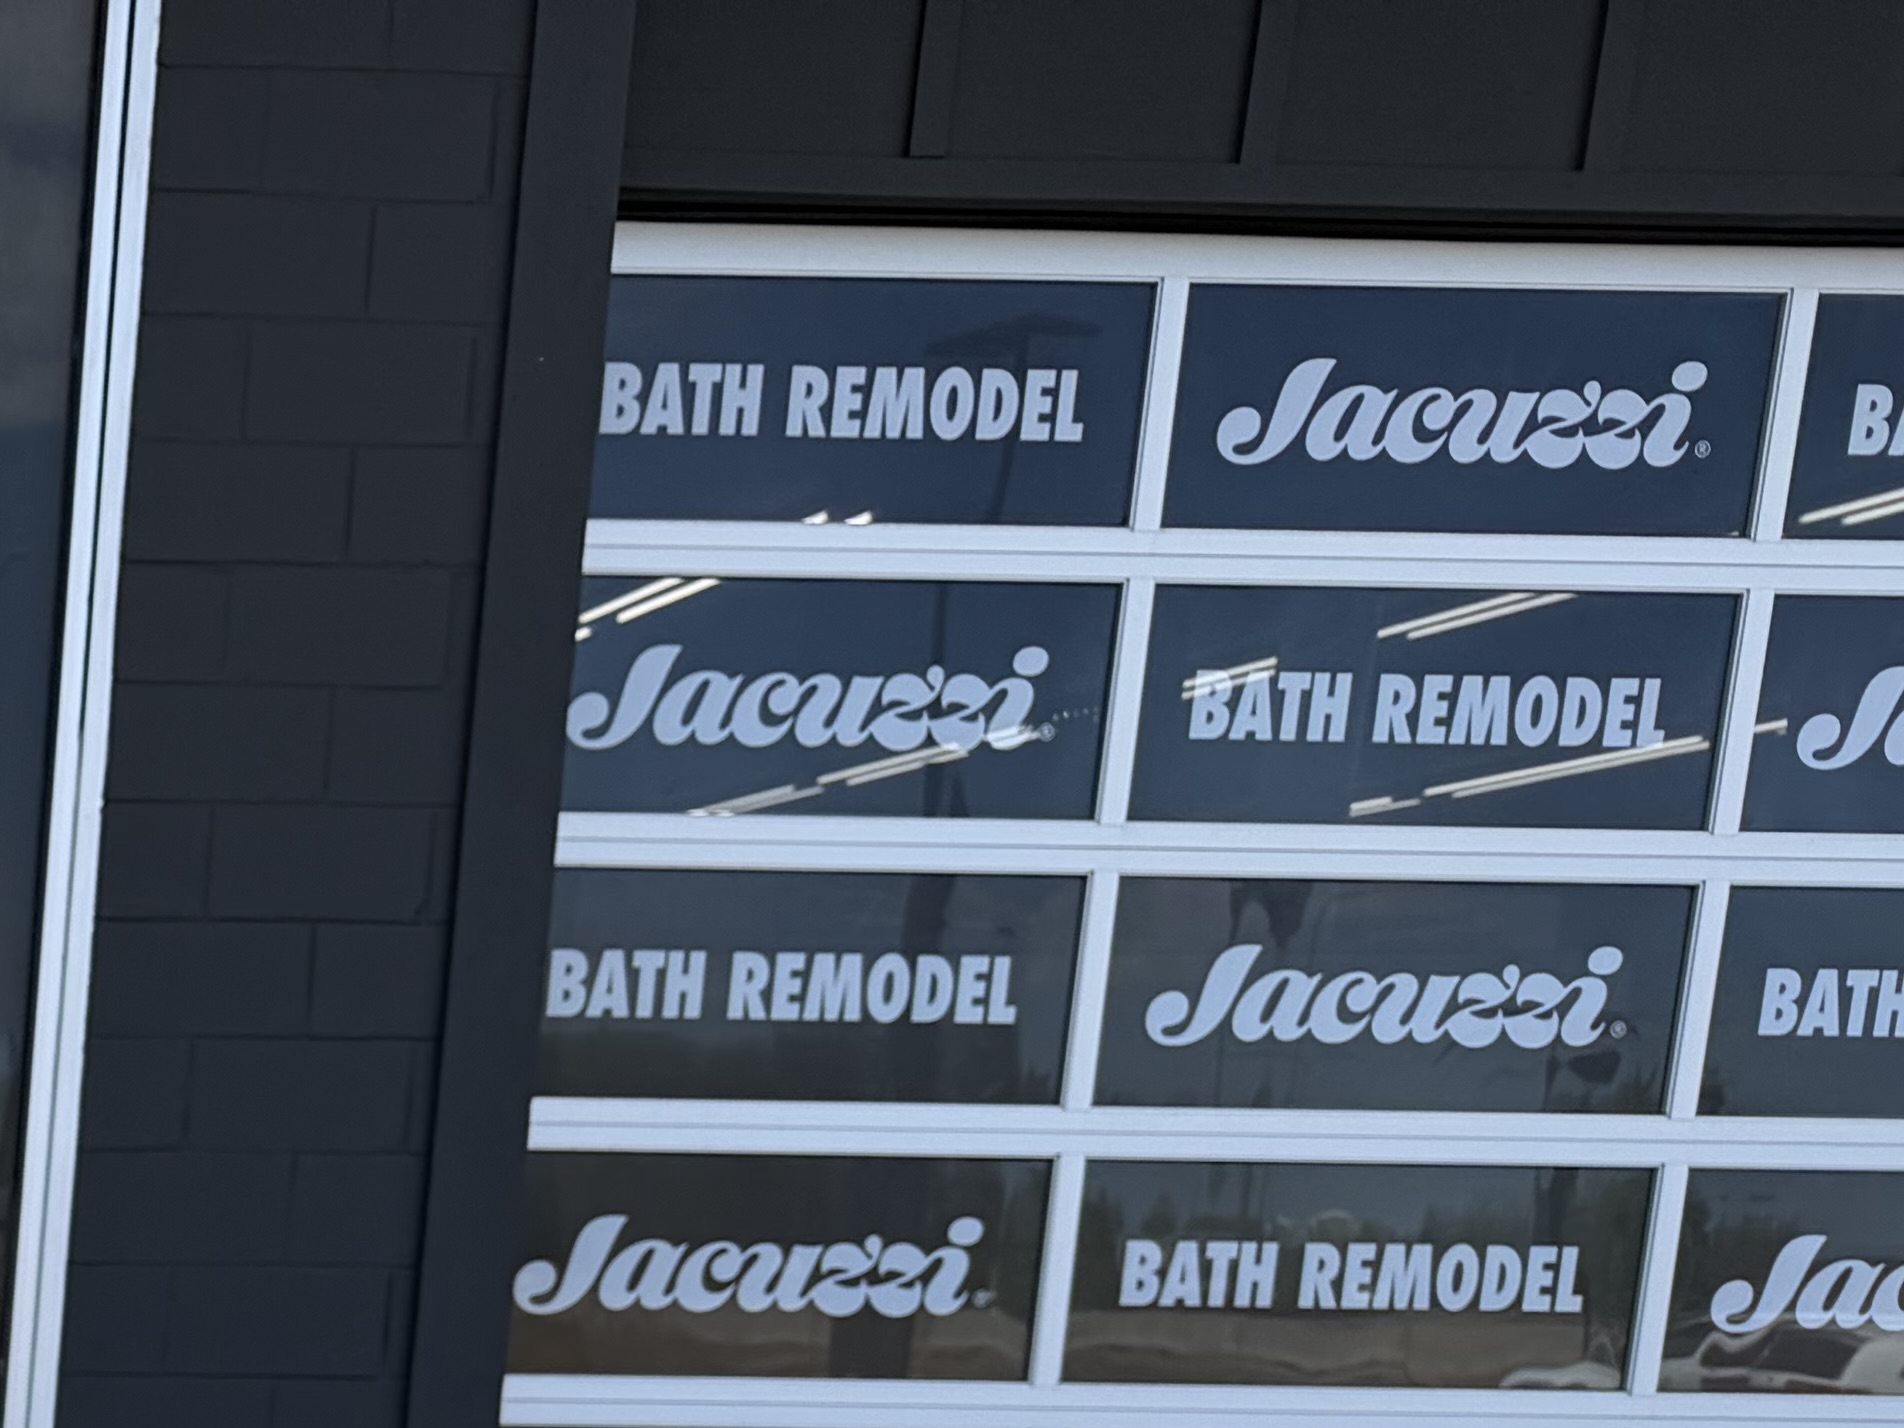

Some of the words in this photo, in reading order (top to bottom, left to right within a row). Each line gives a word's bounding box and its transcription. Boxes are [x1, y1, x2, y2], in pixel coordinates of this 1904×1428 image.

[599, 362, 761, 436] BATH
[785, 365, 1084, 442] REMODEL
[1847, 383, 1904, 457] B
[1188, 669, 1353, 742] BATH
[1371, 673, 1666, 748] REMODEL
[1796, 665, 1904, 771] J
[545, 949, 707, 1019] BATH
[726, 951, 1017, 1025] REMODEL
[1118, 1239, 1279, 1309] BATH
[1297, 1242, 1583, 1313] REMODEL
